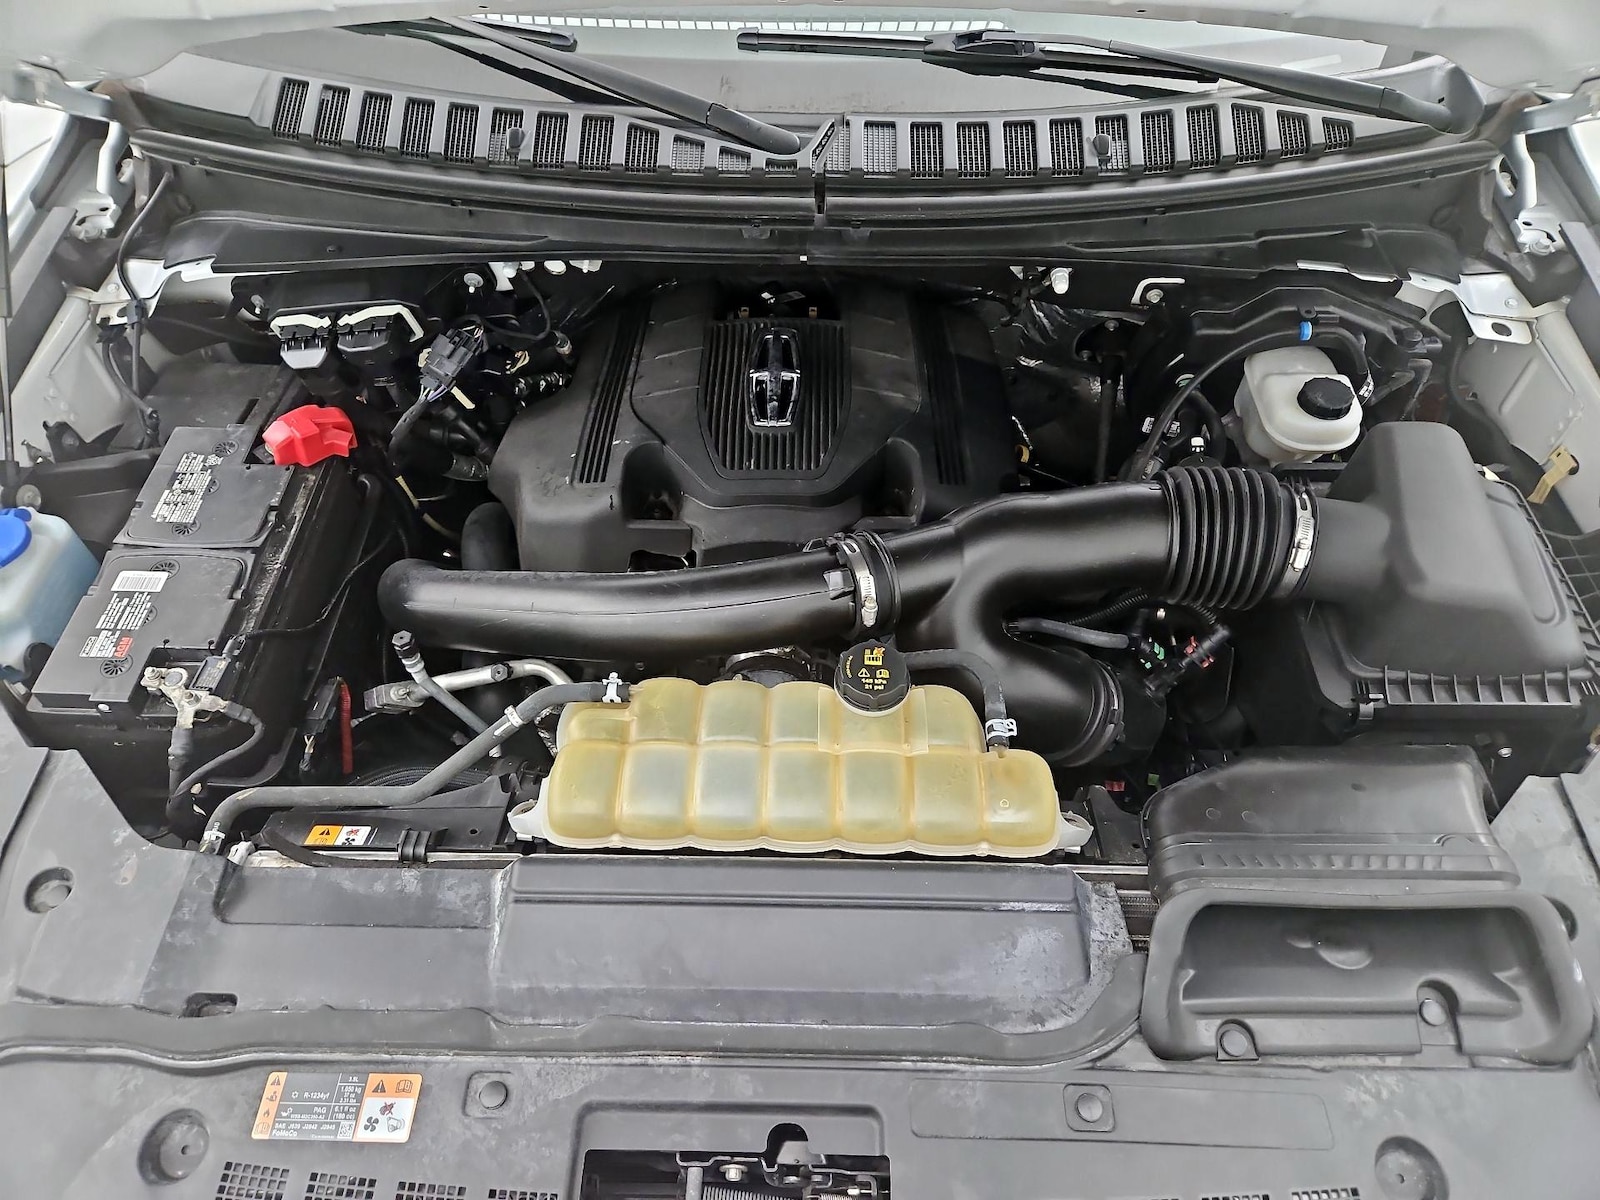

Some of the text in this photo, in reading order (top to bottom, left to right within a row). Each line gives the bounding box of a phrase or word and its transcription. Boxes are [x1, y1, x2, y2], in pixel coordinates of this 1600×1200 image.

[114, 636, 131, 658] AGM
[355, 1086, 362, 1095] kg
[303, 1091, 330, 1100] R-1234yf
[275, 1122, 287, 1130] SAE
[271, 1129, 298, 1137] FoMoCo
